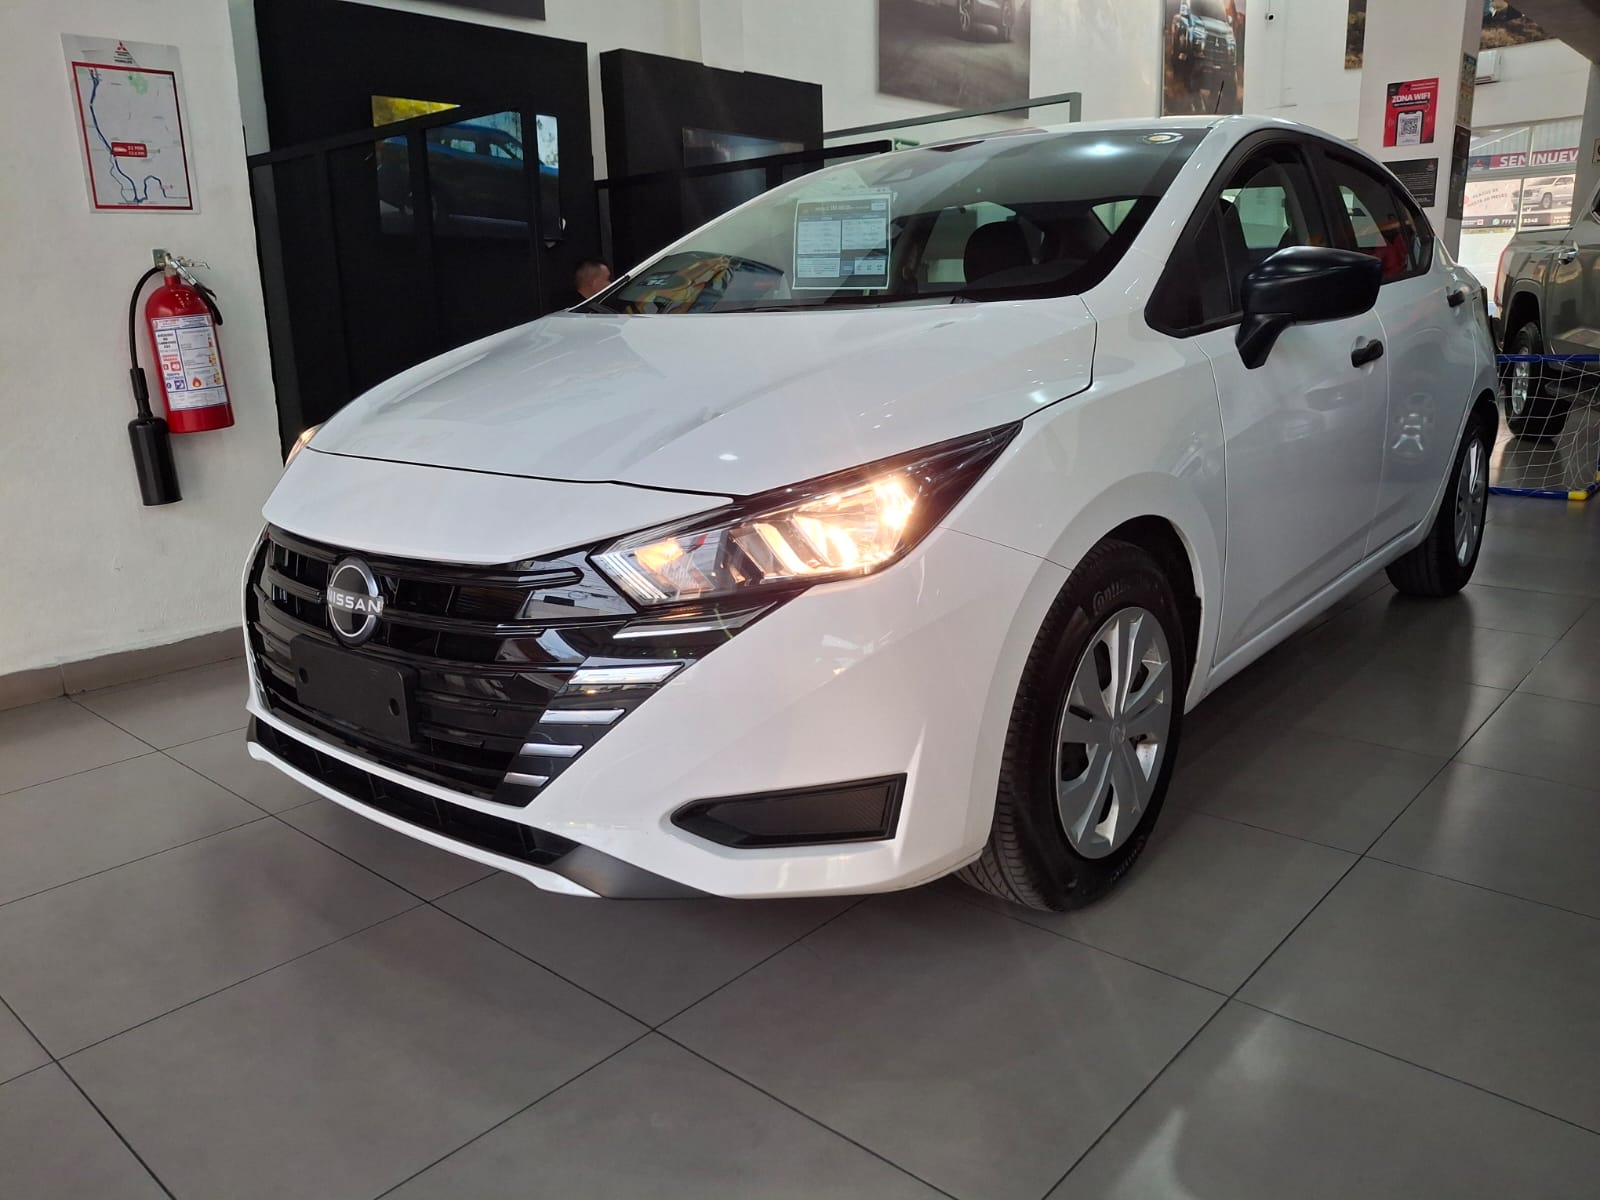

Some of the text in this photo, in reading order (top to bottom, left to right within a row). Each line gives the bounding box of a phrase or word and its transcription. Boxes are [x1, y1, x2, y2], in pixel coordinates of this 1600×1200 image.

[1391, 92, 1431, 103] ZONA WIFI
[327, 589, 381, 613] NISSAN
